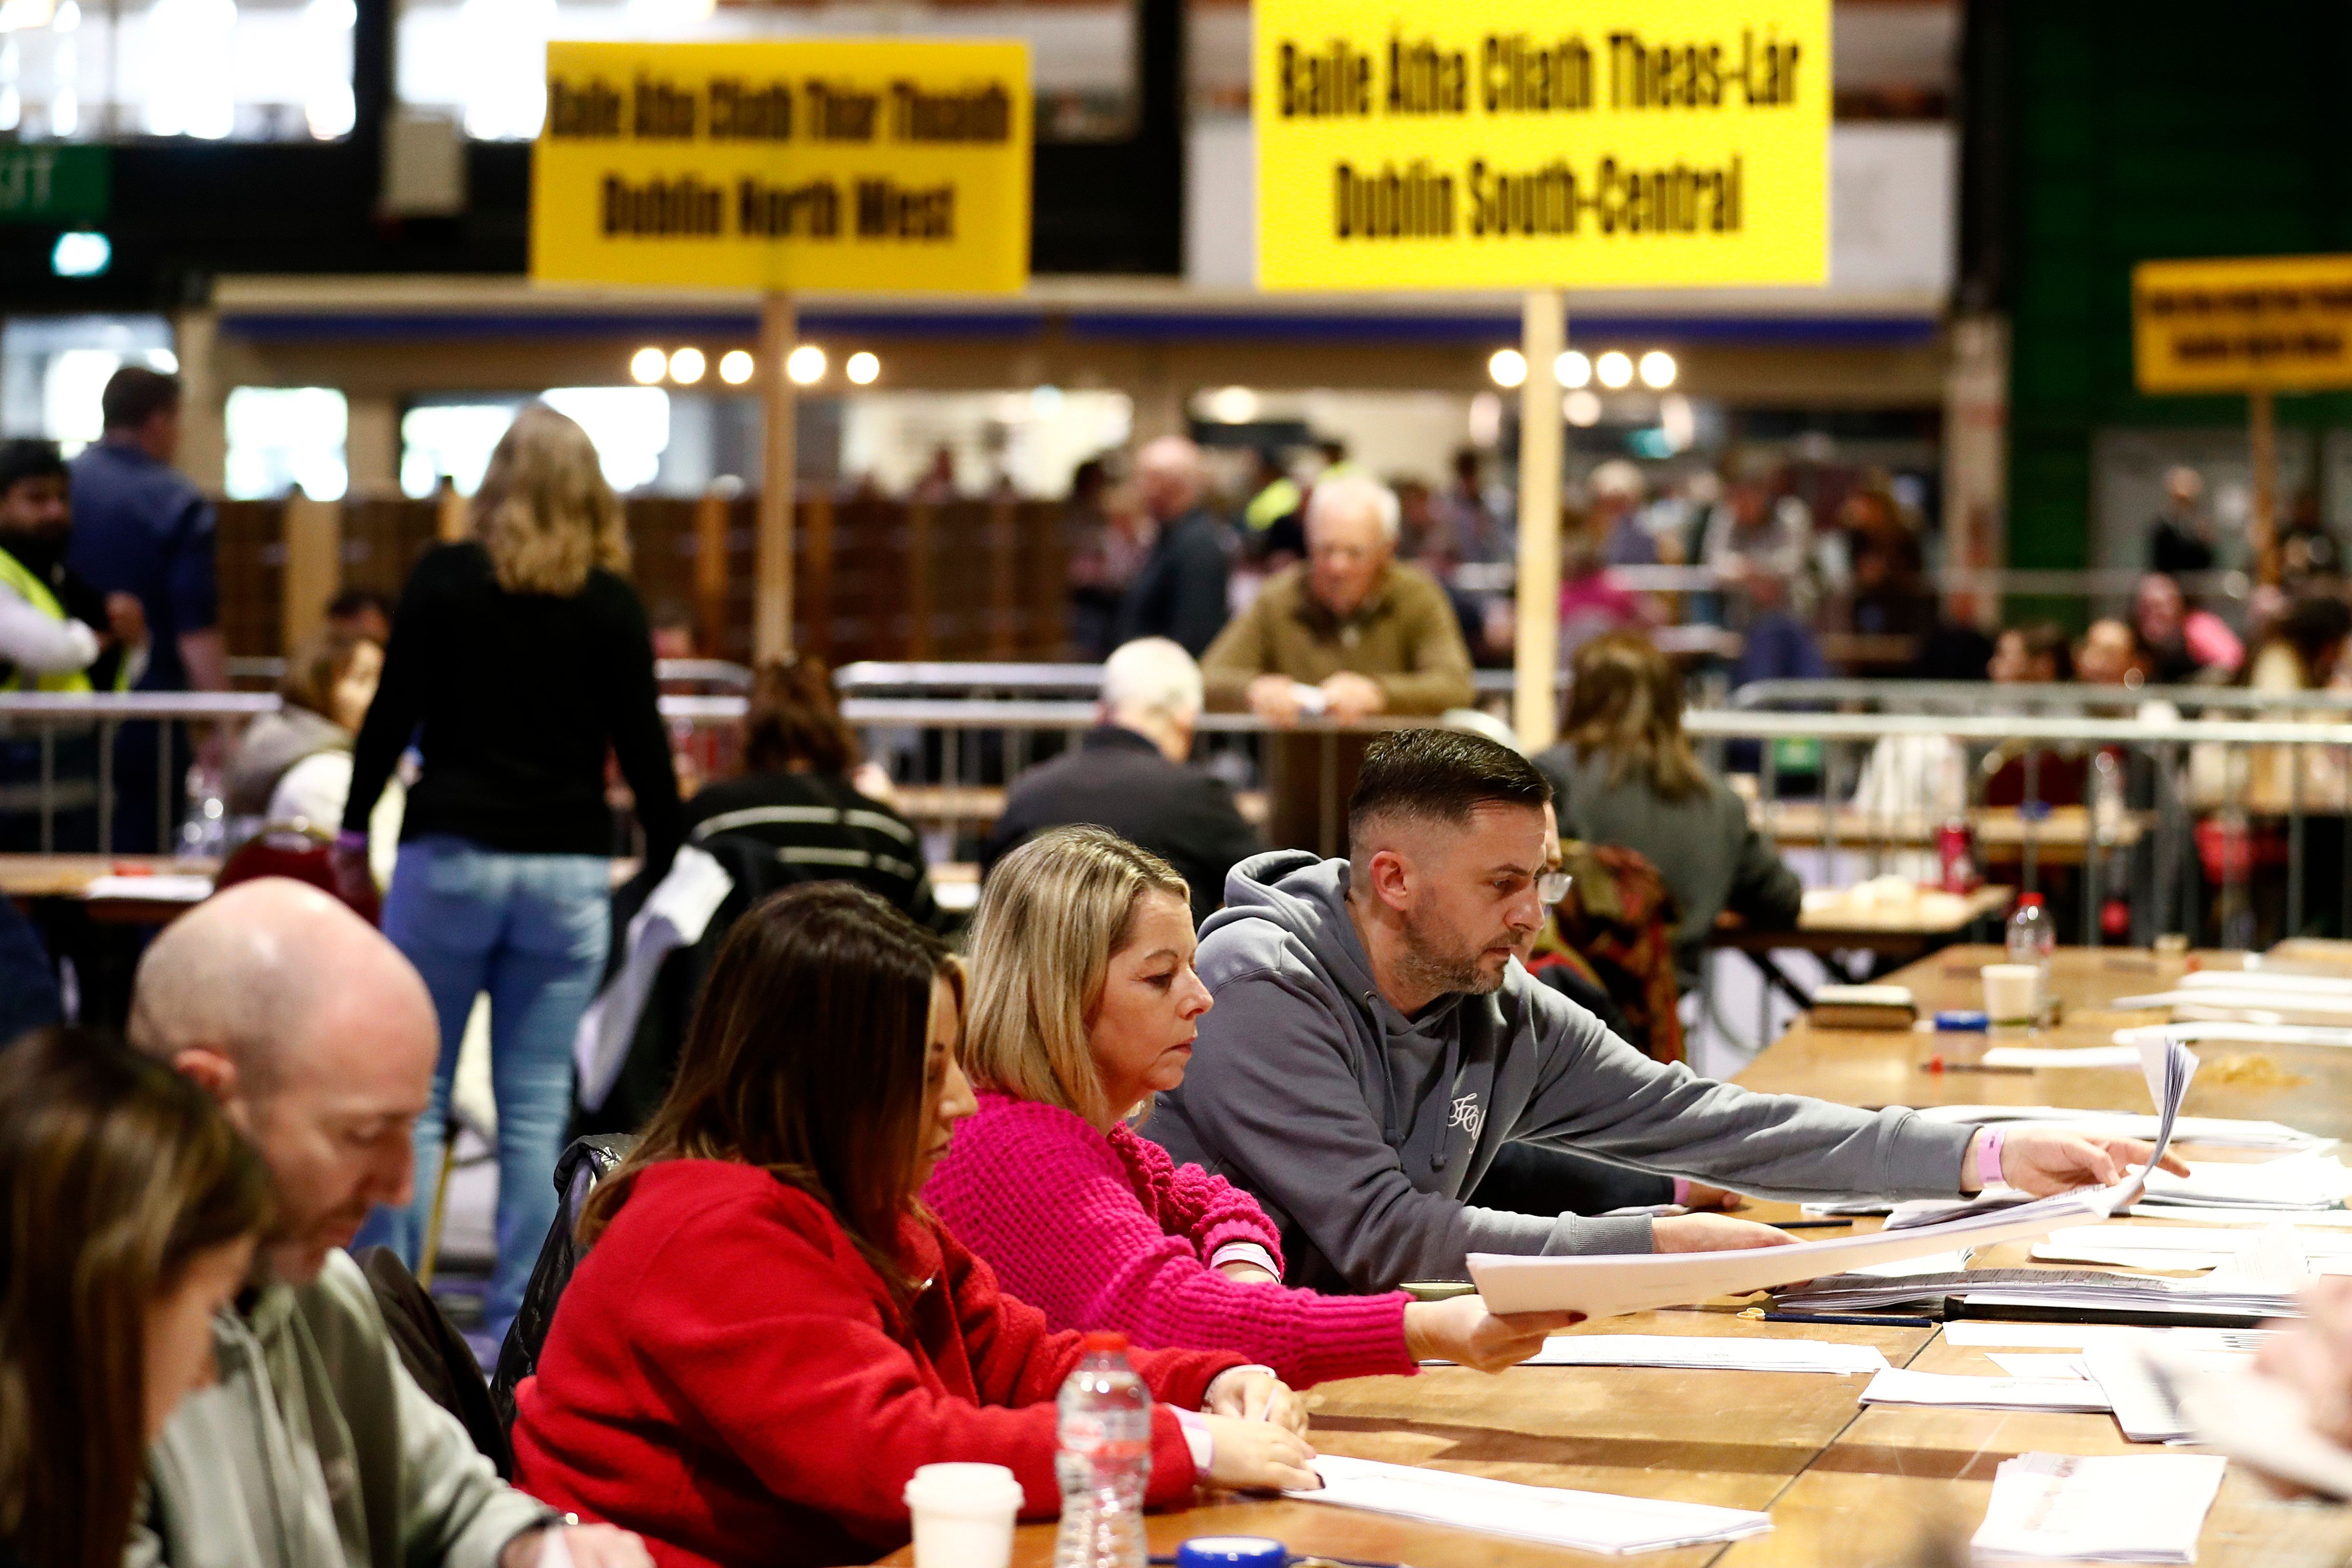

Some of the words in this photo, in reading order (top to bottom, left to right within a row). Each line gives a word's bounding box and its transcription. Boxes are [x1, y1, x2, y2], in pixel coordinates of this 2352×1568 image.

[1278, 40, 1371, 116] Baile
[1382, 20, 1468, 115] Átha
[1480, 34, 1595, 112] Cliath
[1607, 24, 1799, 107] Theas-Lár
[600, 173, 725, 240] Dublin
[853, 174, 955, 241] West
[1334, 159, 1456, 238] Dublin
[1469, 153, 1743, 236] South-Central
